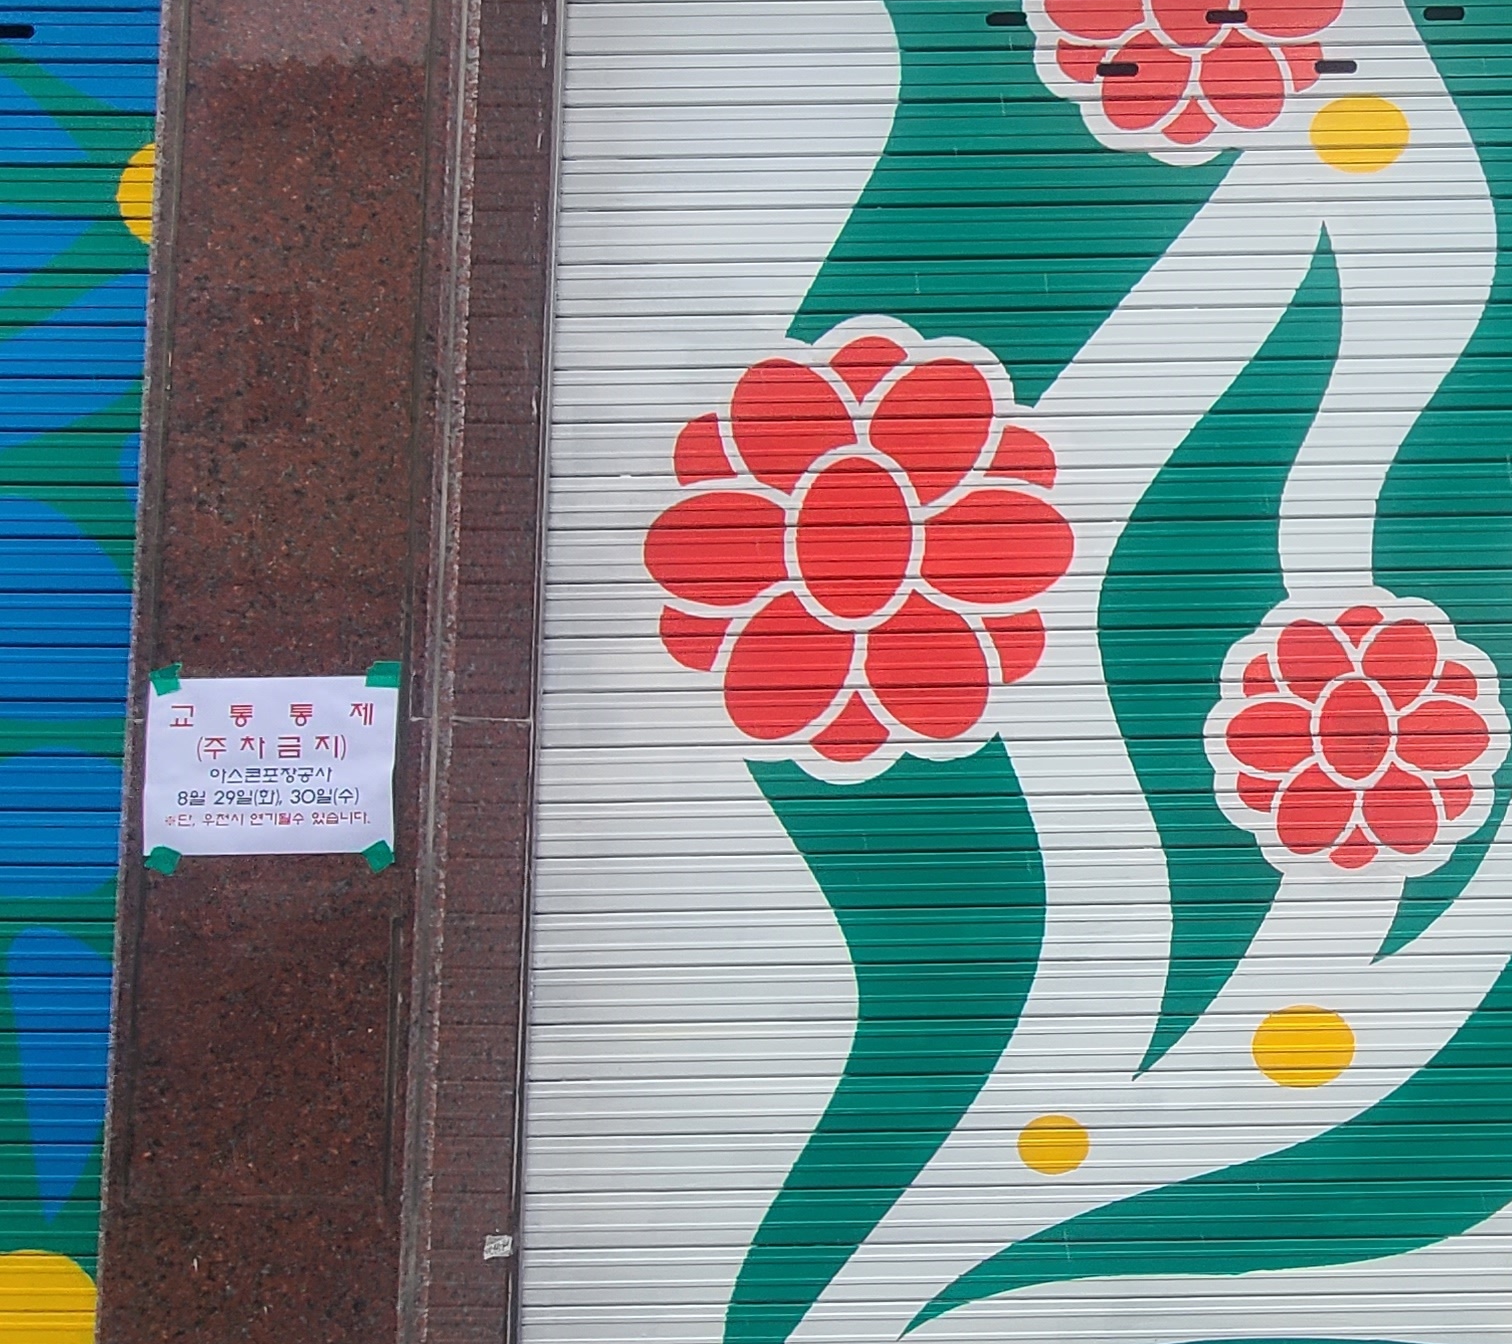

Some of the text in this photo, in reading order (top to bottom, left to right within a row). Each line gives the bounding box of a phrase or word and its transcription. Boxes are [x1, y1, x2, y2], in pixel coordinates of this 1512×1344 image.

[209, 766, 333, 784] 아스콘포장공사
[177, 789, 206, 806] 8월
[289, 787, 360, 806] 30일(수)
[311, 810, 371, 826] 있습니다.
